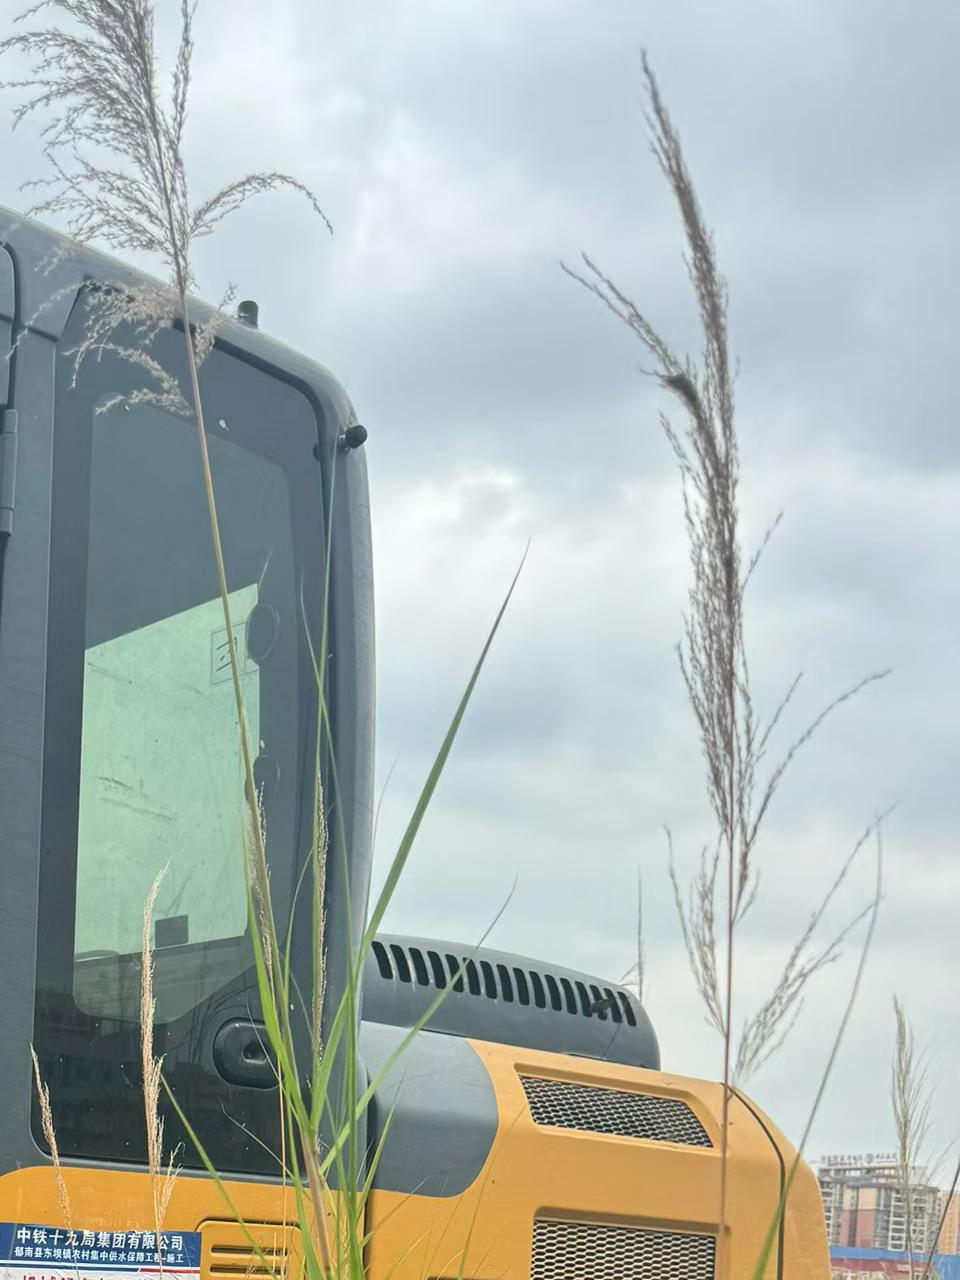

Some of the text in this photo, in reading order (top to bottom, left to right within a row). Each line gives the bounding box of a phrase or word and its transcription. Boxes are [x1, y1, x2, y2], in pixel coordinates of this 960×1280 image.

[17, 1226, 183, 1251] 中铁十九局集团有限公司
